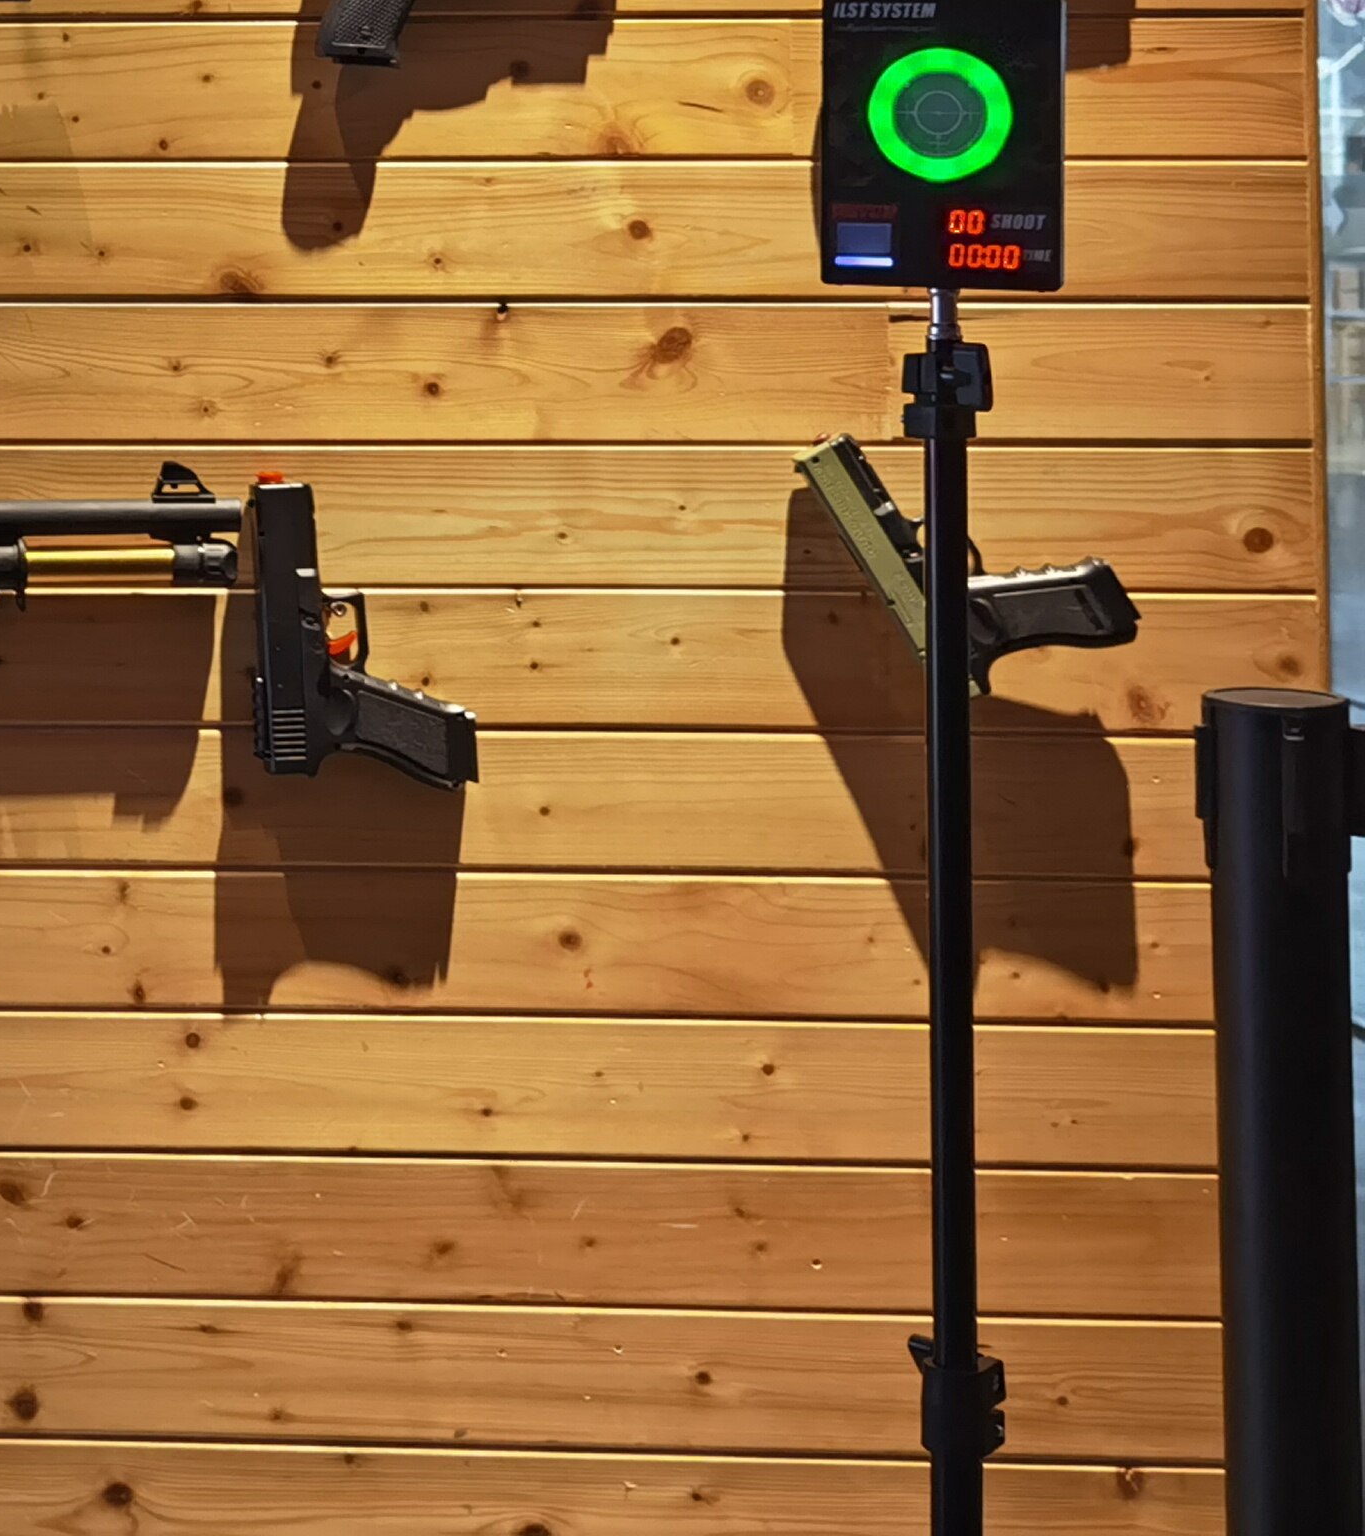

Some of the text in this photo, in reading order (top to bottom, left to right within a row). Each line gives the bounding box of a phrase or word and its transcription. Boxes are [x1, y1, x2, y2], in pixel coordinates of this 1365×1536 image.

[833, 2, 937, 19] ILST SYSTEM
[947, 209, 1047, 235] 00 SHOOT
